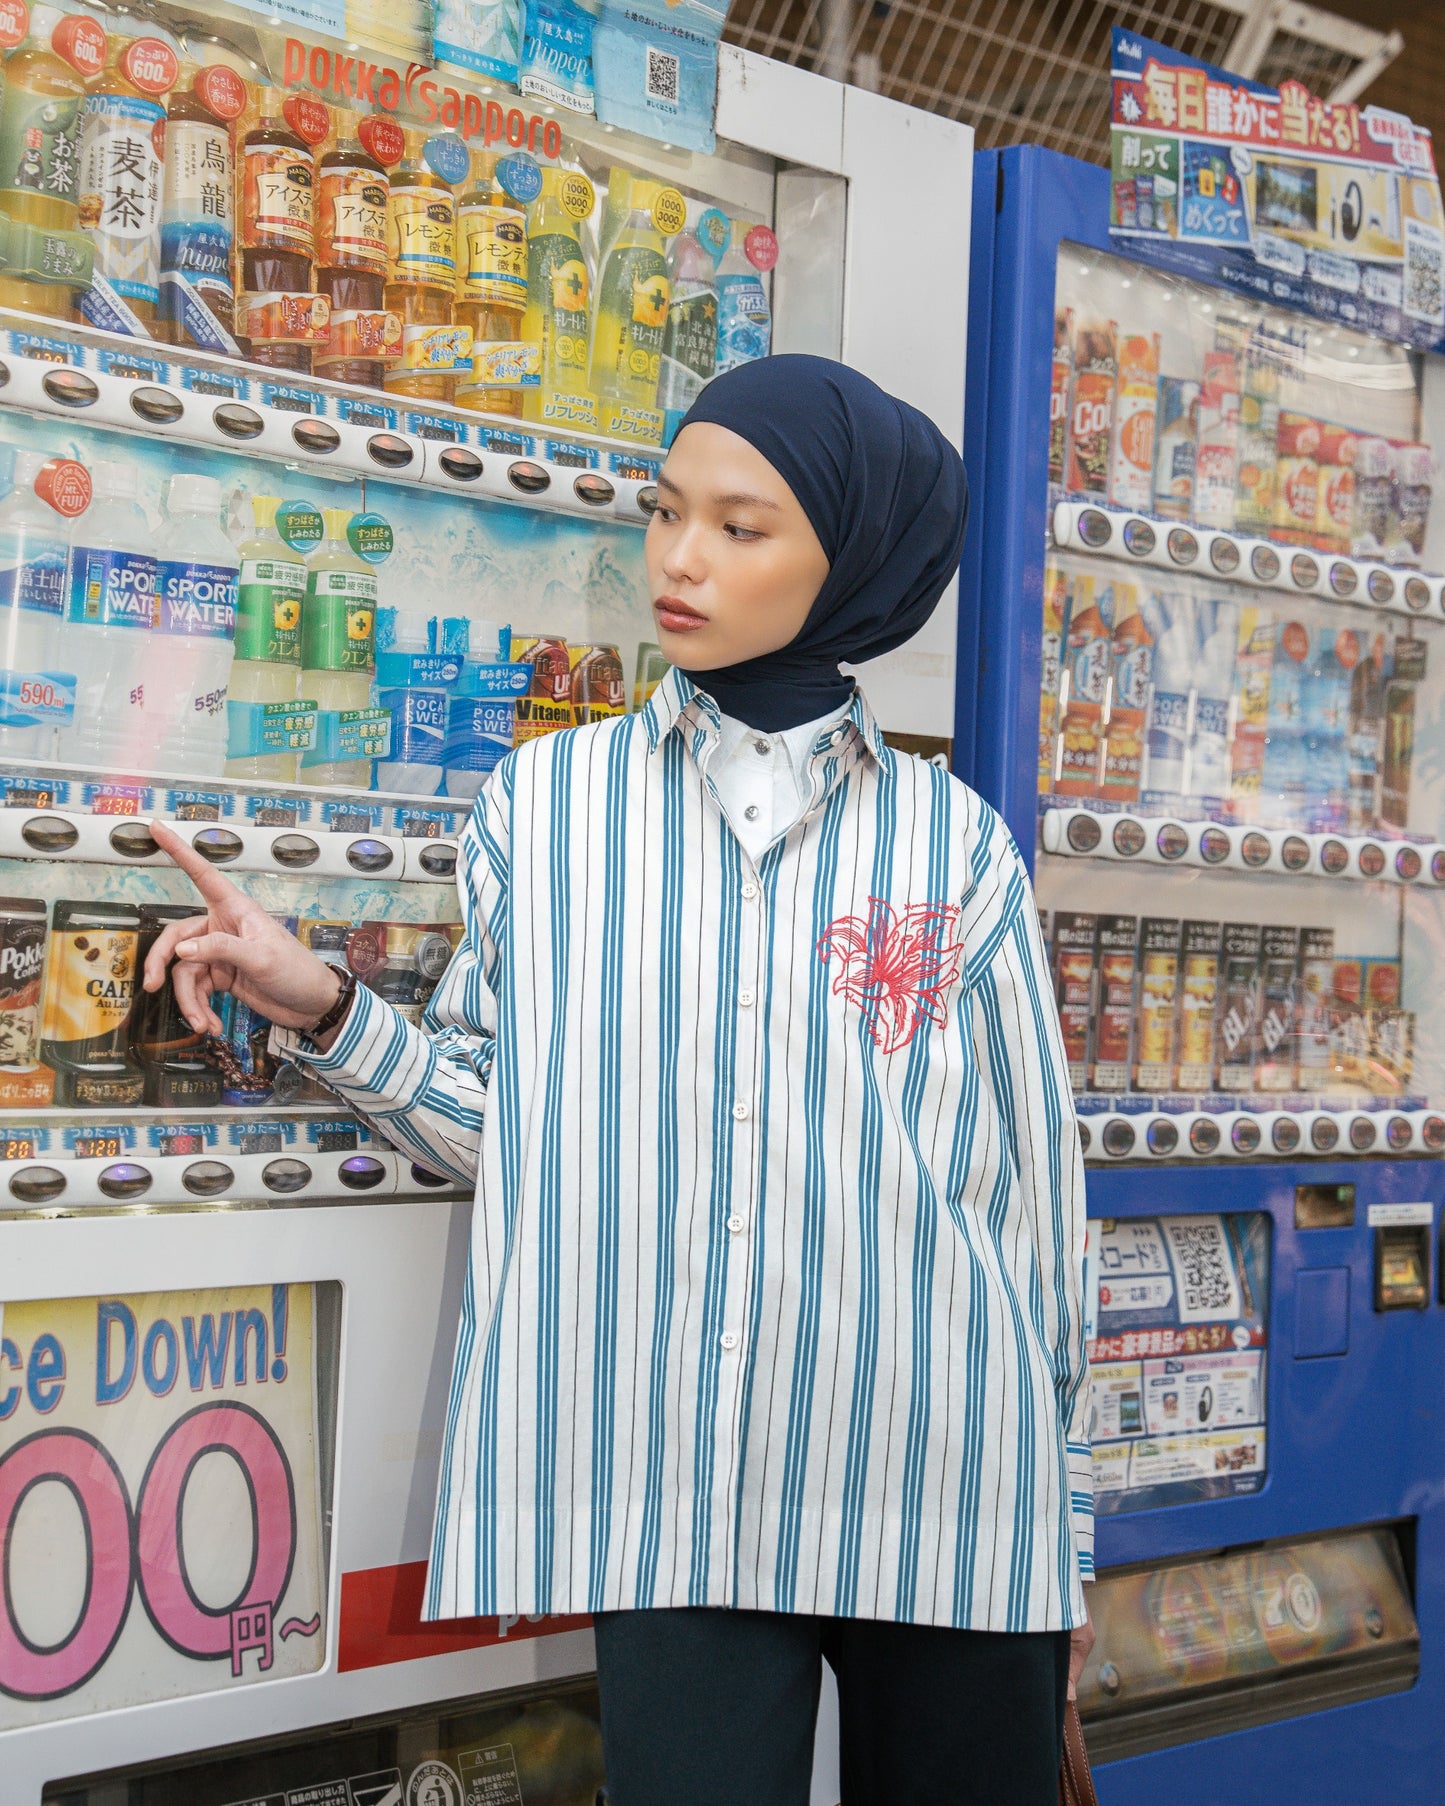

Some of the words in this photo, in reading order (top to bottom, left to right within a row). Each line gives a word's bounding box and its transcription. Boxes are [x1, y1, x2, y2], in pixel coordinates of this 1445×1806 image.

[135, 47, 169, 62] たっぷり
[528, 37, 591, 77] nippon
[133, 60, 170, 84] 600ml
[208, 74, 240, 90] やさしい
[1121, 135, 1172, 171] 削って
[48, 131, 73, 193] お茶
[516, 158, 535, 174] 甘さ
[104, 136, 147, 229] 麦茶
[200, 138, 226, 219] 烏龍
[509, 169, 538, 186] すっきり
[1184, 203, 1243, 236] めくって
[43, 256, 73, 275] うまみ
[496, 258, 522, 275] 微糖
[16, 333, 79, 355] つめた〜い
[106, 351, 163, 372] つめた〜い
[188, 369, 245, 388] つめた〜い
[267, 384, 321, 403] つめた〜い
[344, 400, 394, 418] つめた〜い
[413, 414, 464, 433] つめた〜い
[484, 428, 531, 446] つめた〜い
[551, 441, 595, 458] つめた〜い
[614, 454, 657, 469] つめた〜い
[61, 496, 83, 508] FUJI
[287, 514, 320, 527] すっぱさが
[289, 528, 321, 539] しみわたる
[357, 528, 390, 540] すっぱさが
[360, 541, 390, 551] しみわたる
[20, 567, 63, 589] 富士山
[167, 600, 234, 626] WATER
[413, 658, 441, 670] 飲みきり
[421, 670, 441, 681] サイズ
[479, 669, 509, 680] 飲みきり
[488, 681, 509, 691] サイズ
[20, 682, 65, 708] 590ml
[195, 685, 228, 712] 550ml
[2, 777, 63, 793] つめた〜い
[90, 784, 149, 799] つめた〜い
[174, 791, 229, 805] つめた〜い
[254, 797, 305, 811] つめた〜い
[93, 799, 135, 816] ¥130
[329, 803, 378, 815] つめた〜い
[401, 808, 450, 822] つめた〜い
[95, 998, 112, 1009] Au
[70, 1126, 130, 1138] つめた〜い
[156, 1125, 212, 1136] つめた〜い
[236, 1123, 290, 1134] つめた〜い
[75, 1140, 117, 1158] ¥120
[96, 1284, 289, 1406] Down!
[411, 1765, 455, 1793] のんだあとは
